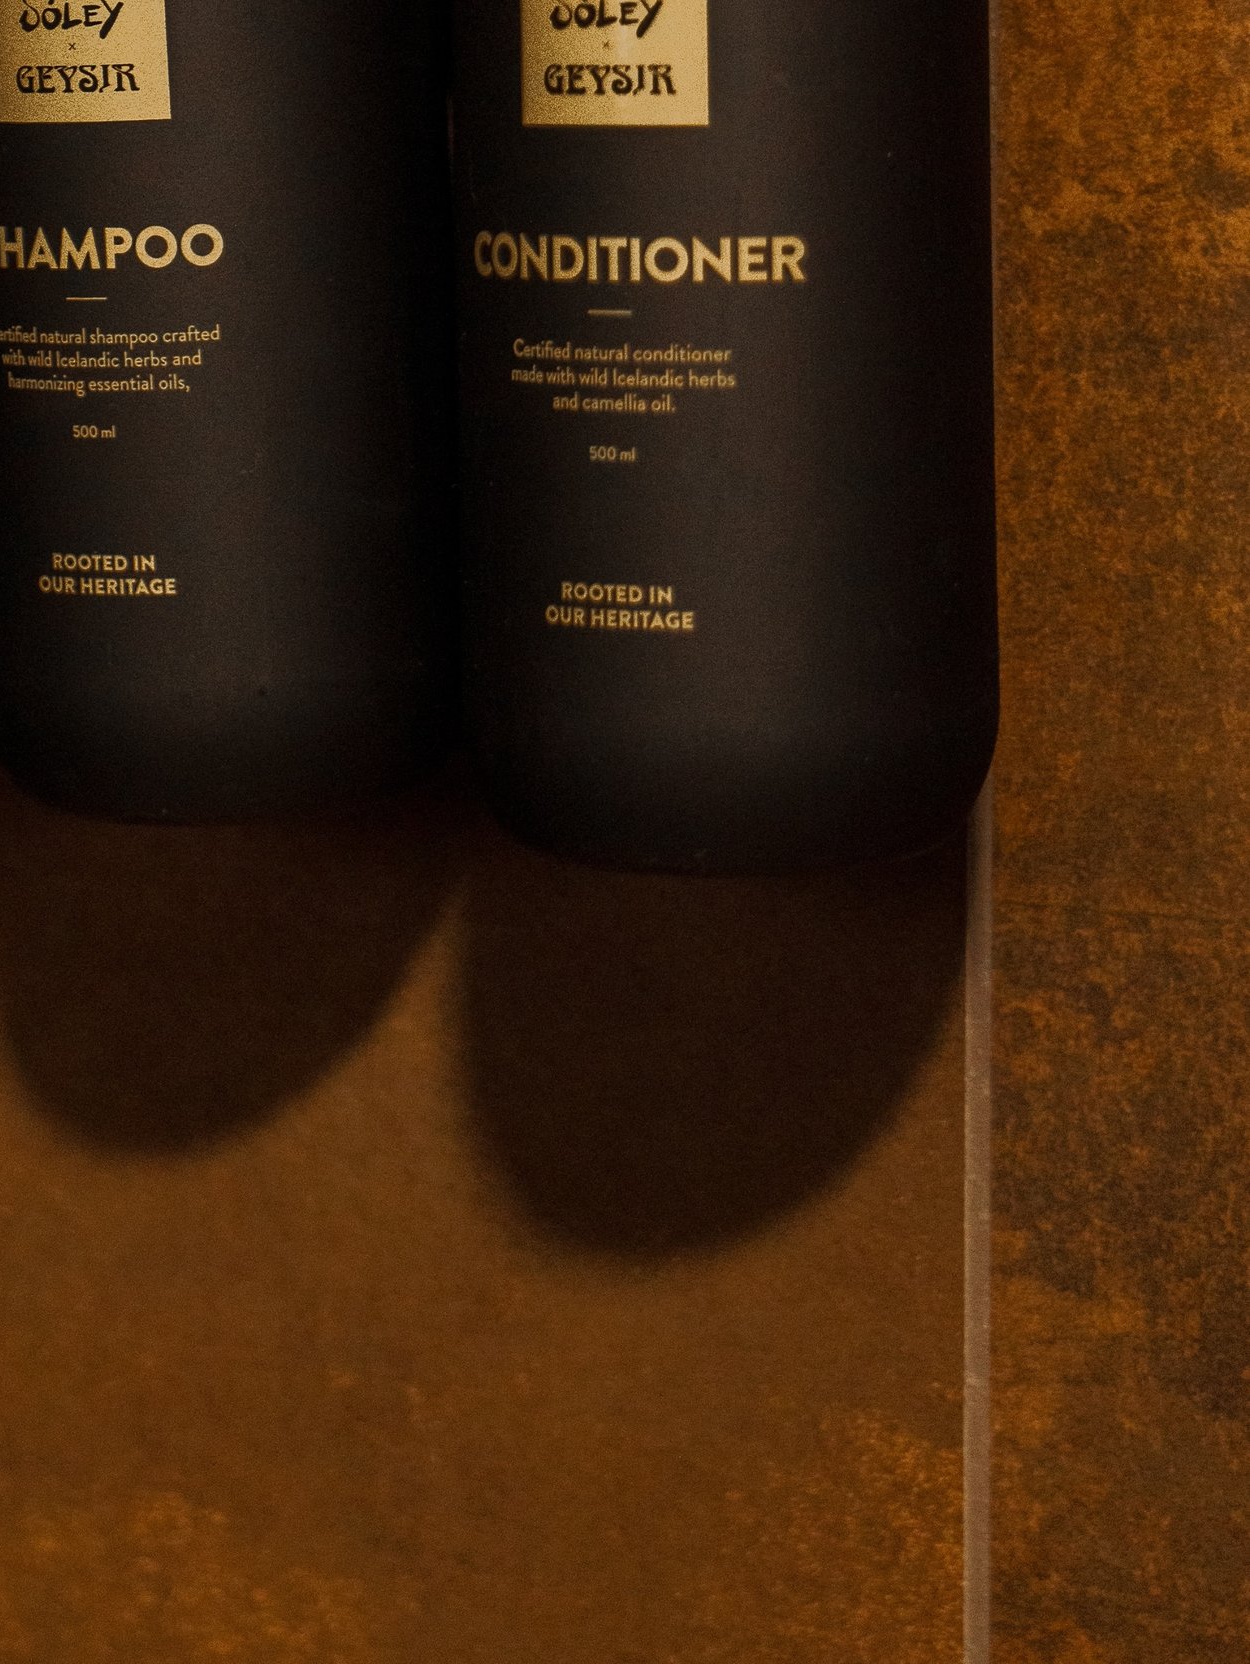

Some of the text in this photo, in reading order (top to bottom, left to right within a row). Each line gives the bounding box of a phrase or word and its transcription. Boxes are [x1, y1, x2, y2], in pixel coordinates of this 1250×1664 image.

[16, 63, 140, 94] GEYSIR
[544, 64, 676, 96] GEYSIR
[475, 230, 806, 283] CONDITIONER
[40, 328, 86, 345] natural
[89, 327, 158, 350] shampoo
[162, 323, 221, 342] crafted
[2, 348, 202, 368] with wild Icelandic herbs and
[513, 338, 732, 363] Certified natural conditioner
[8, 371, 191, 397] harmonizing essential oils,
[511, 365, 737, 388] made with wild Icelandic herbs
[552, 392, 676, 413] and camellia oil.
[73, 424, 116, 439] 500 ml
[589, 445, 636, 462] 500 ml
[52, 553, 156, 572] ROOTED IN
[39, 575, 177, 596] OUR HERITAGE
[561, 581, 673, 604] ROOTED IN
[545, 605, 694, 630] OUR HERITAGE
